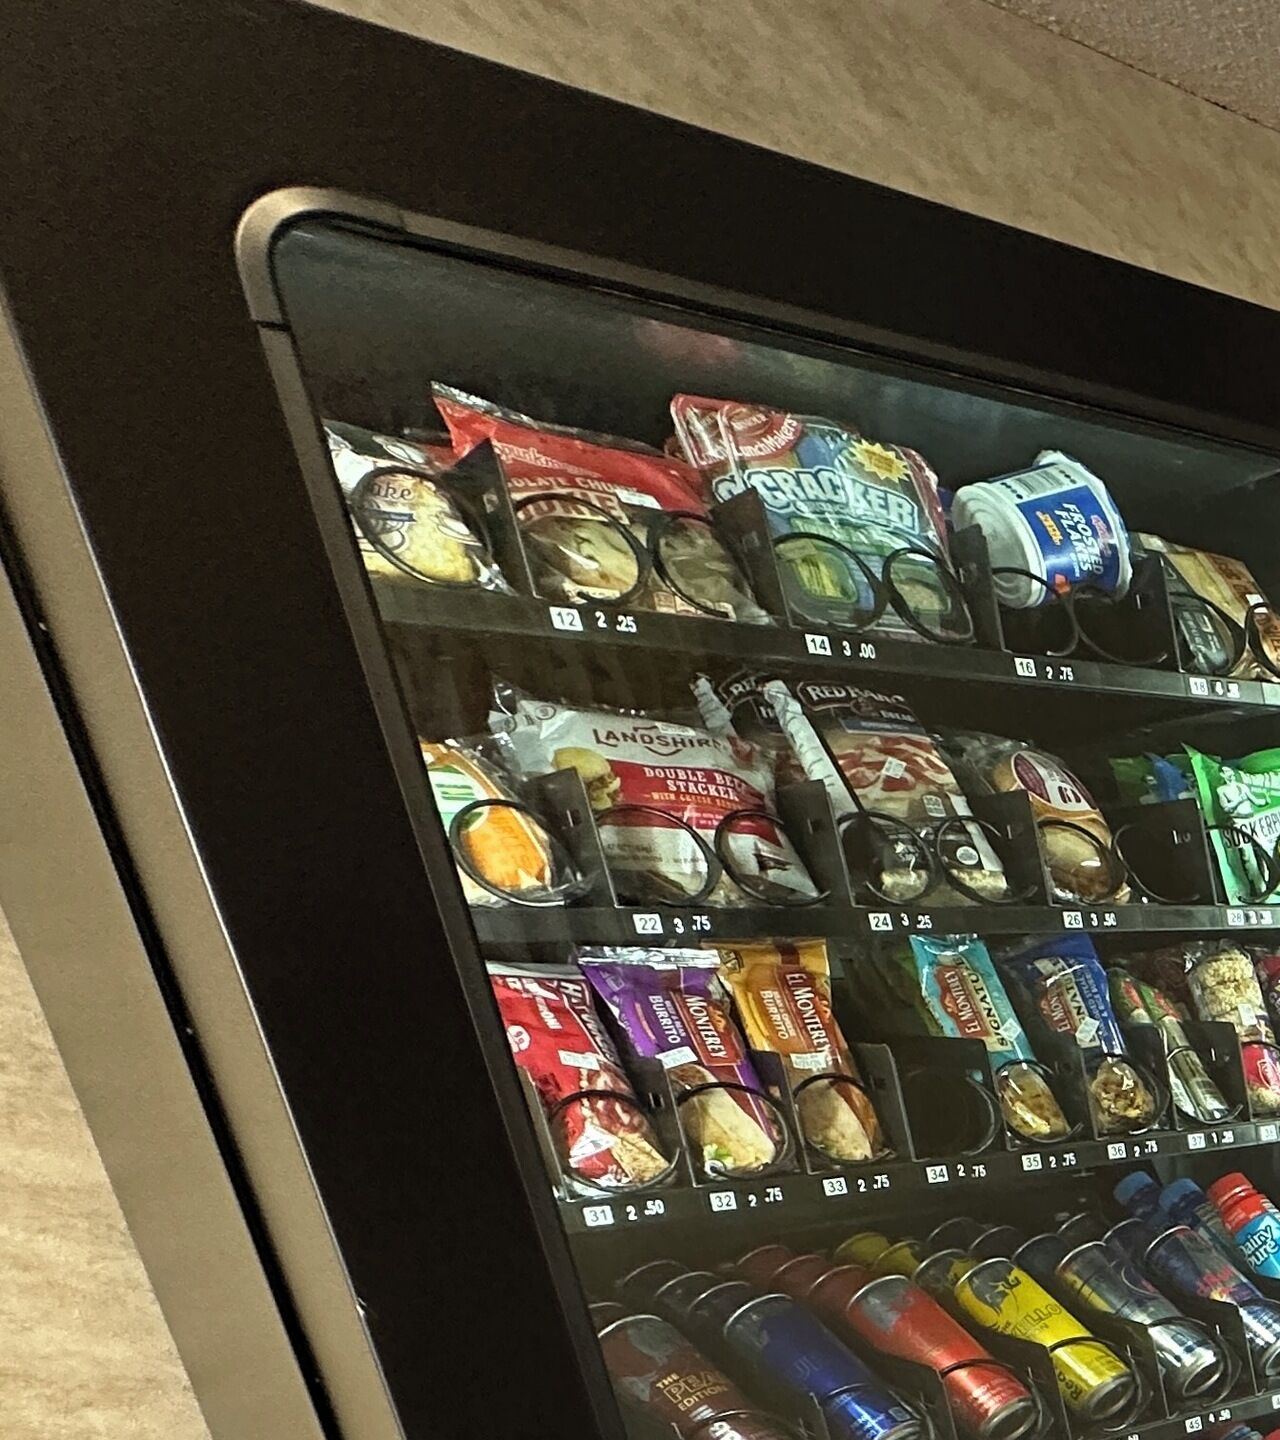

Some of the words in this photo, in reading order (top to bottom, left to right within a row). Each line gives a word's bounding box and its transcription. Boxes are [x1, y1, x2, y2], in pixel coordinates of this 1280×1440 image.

[1054, 509, 1092, 573] FLAKES
[1062, 502, 1104, 575] FROSTED
[556, 613, 577, 627] 12
[595, 611, 607, 628] 2
[616, 614, 637, 633] .25
[810, 637, 827, 652] 14
[843, 641, 851, 656] 3
[859, 643, 876, 659] .00
[1019, 660, 1033, 675] 16
[1060, 667, 1073, 681] .75
[643, 766, 707, 783] DOUBLE
[639, 916, 659, 931] 22
[674, 917, 685, 934] 3
[692, 915, 711, 931] .75
[873, 915, 889, 929] 24
[901, 913, 909, 926] 3
[917, 915, 933, 930] .25
[1067, 913, 1080, 926] 26
[1090, 912, 1098, 927] 3
[785, 972, 808, 986] EL
[943, 969, 977, 1023] MONTEREY
[647, 994, 681, 1045] BURRITO
[760, 990, 790, 1040] BURRITO
[790, 986, 831, 1053] MONTEREY
[684, 994, 729, 1060] MONTEREY
[965, 1020, 981, 1034] EL
[1026, 1155, 1039, 1168] 35
[1049, 1156, 1057, 1168] 2
[1062, 1153, 1077, 1167] .75
[1110, 1145, 1123, 1157] 36
[1133, 1146, 1140, 1158] 2
[930, 1168, 945, 1180] 34
[957, 1164, 966, 1177] 2
[971, 1164, 987, 1178] .75
[828, 1180, 844, 1193] 33
[857, 1179, 866, 1193] 2
[873, 1174, 890, 1190] .75
[715, 1194, 733, 1208] 32
[748, 1194, 757, 1208] 2
[764, 1187, 783, 1203] .75
[589, 1209, 608, 1223] 31
[626, 1205, 637, 1221] 2
[644, 1200, 665, 1216] .50
[655, 1372, 680, 1389] THE
[677, 1385, 729, 1412] EDITION
[1188, 1419, 1201, 1430] 45
[1208, 1411, 1215, 1423] 4
